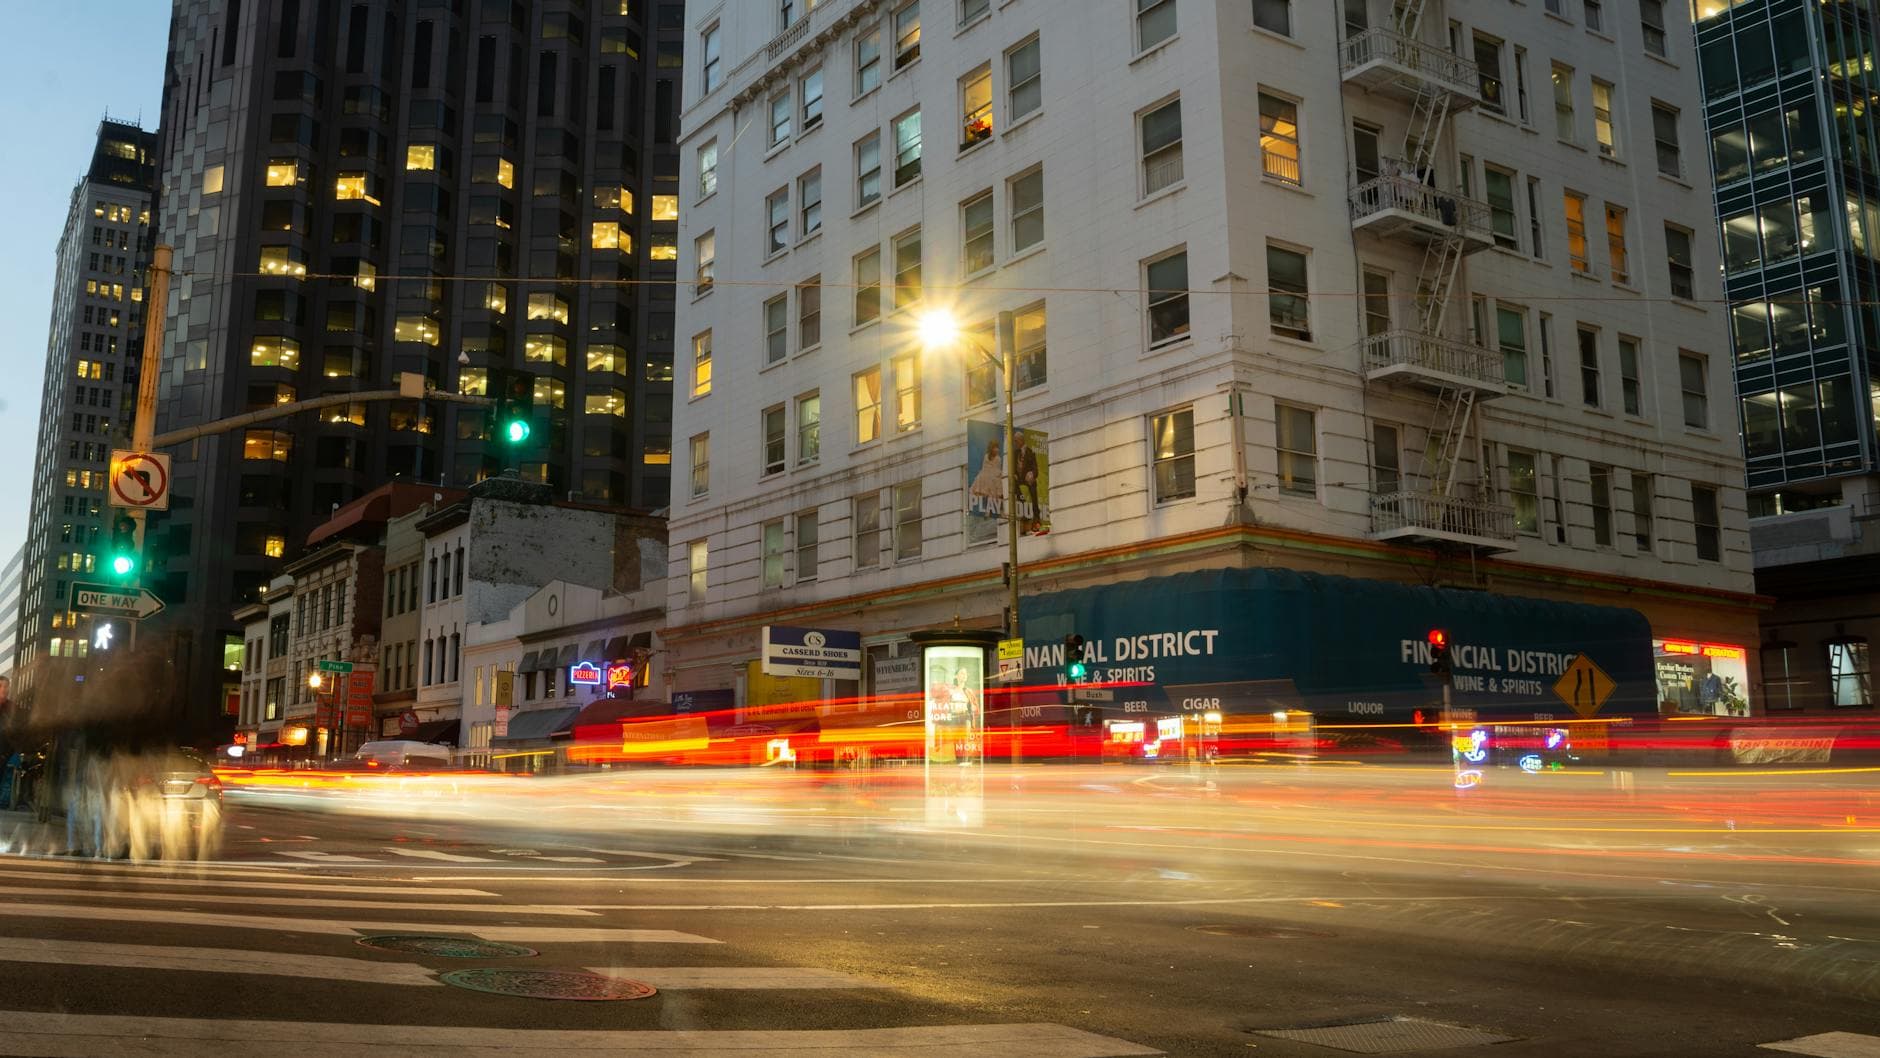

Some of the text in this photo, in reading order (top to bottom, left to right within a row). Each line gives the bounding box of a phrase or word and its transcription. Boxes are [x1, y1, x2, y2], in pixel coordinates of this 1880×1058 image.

[81, 593, 138, 608] ONE WAY
[808, 635, 822, 645] CS
[823, 649, 848, 658] SHOES
[1023, 630, 1219, 669] NANAL DISTRICT
[1400, 640, 1577, 675] FINNCIAL DISTRIC
[573, 670, 599, 681] PIZZERIA
[795, 667, 815, 676] Sizes
[1056, 666, 1155, 688] WNE & SPIRITS
[1452, 675, 1542, 696] WINE & SPIRITS
[1124, 701, 1148, 713] BEER
[1183, 698, 1220, 710] CIGAR
[1348, 701, 1384, 715] LIQUOR
[929, 713, 953, 721] MORE
[1455, 774, 1483, 785] ATM
